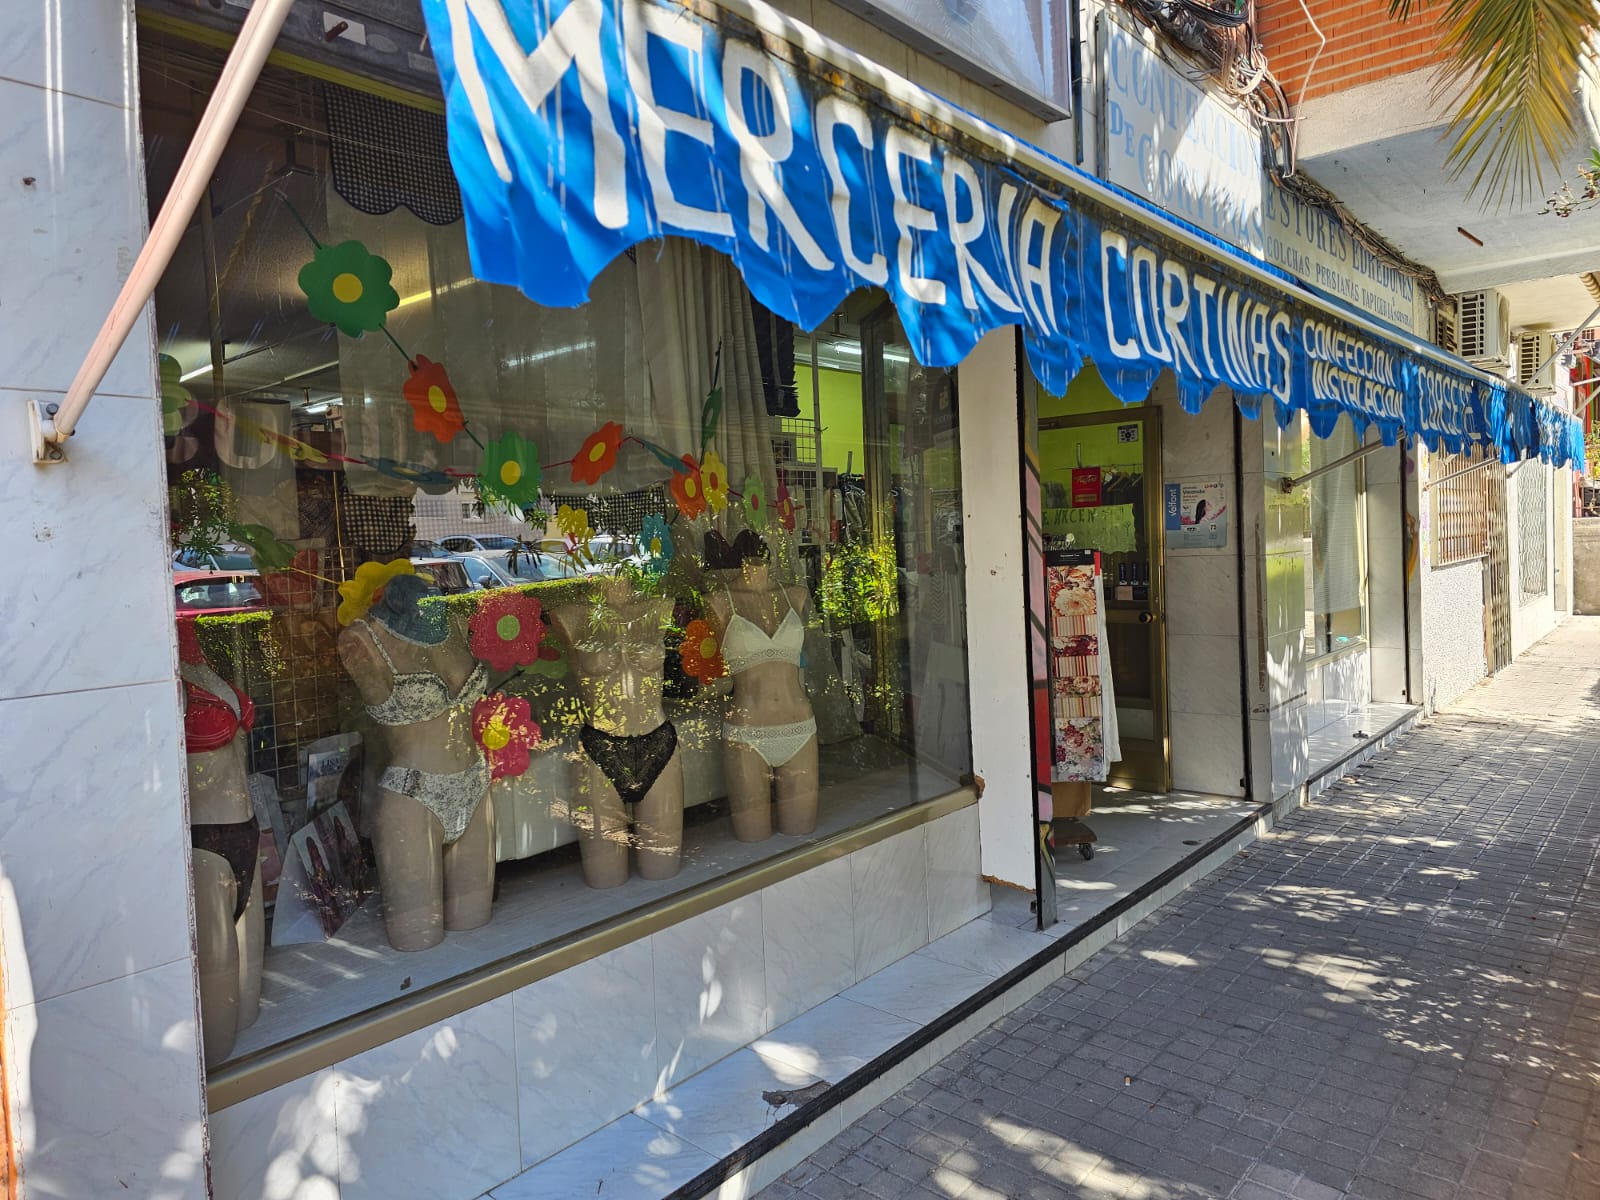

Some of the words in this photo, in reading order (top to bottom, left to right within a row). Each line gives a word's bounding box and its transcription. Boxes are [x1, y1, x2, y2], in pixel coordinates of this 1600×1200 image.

[1110, 100, 1135, 158] DE
[447, 0, 1060, 337] MERCERIA
[1101, 230, 1291, 405] CORTINAS
[1266, 178, 1348, 262] ESTORES
[1351, 236, 1414, 304] EDREDONES
[1266, 236, 1311, 278] COLCHAS
[1315, 262, 1360, 302] PERSIANAS
[1302, 319, 1397, 389] CONFECCION
[1312, 360, 1406, 424] INSTALACION
